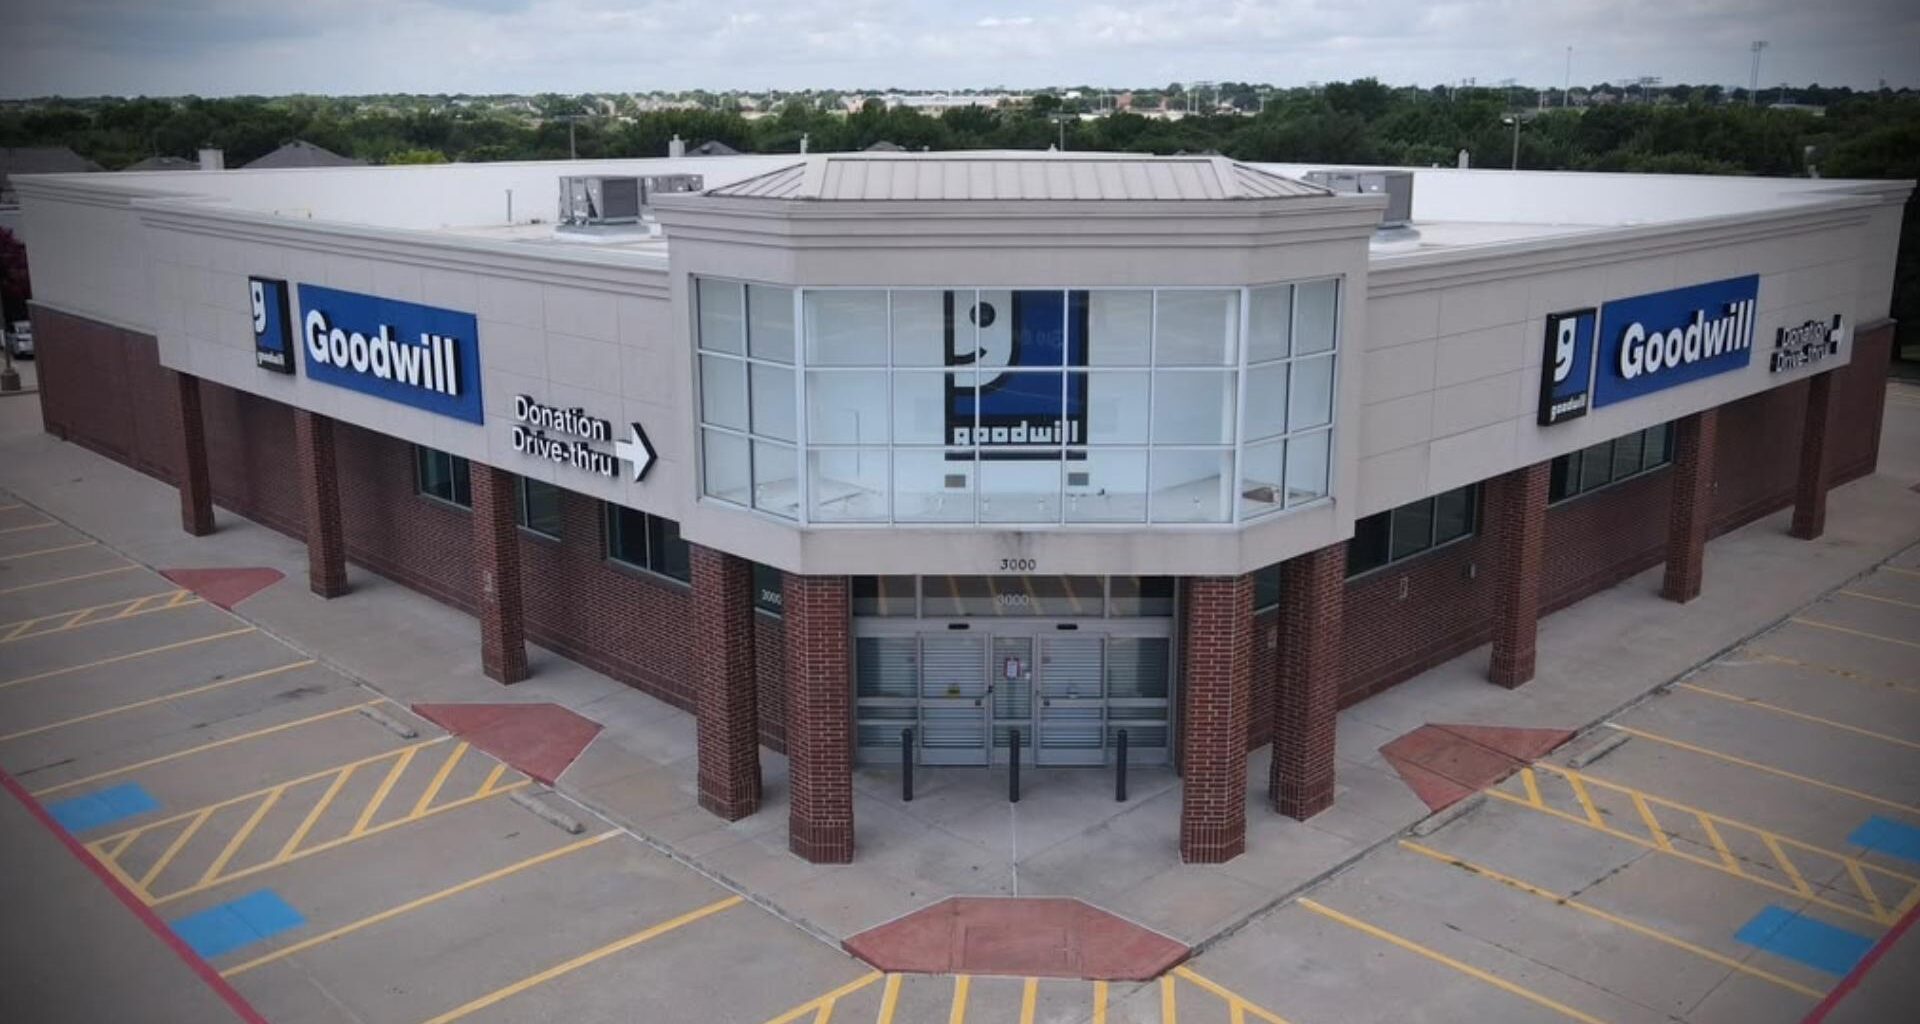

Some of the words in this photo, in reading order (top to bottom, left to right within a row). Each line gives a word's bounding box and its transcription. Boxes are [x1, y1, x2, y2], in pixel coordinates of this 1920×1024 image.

[305, 309, 457, 396] Goodwill
[1621, 299, 1754, 380] Goodwill
[515, 395, 605, 442] Donation
[1551, 393, 1587, 422] goodwill
[512, 426, 612, 477] Drive-thru
[953, 420, 1079, 446] goodwill
[1000, 559, 1037, 571] 3000
